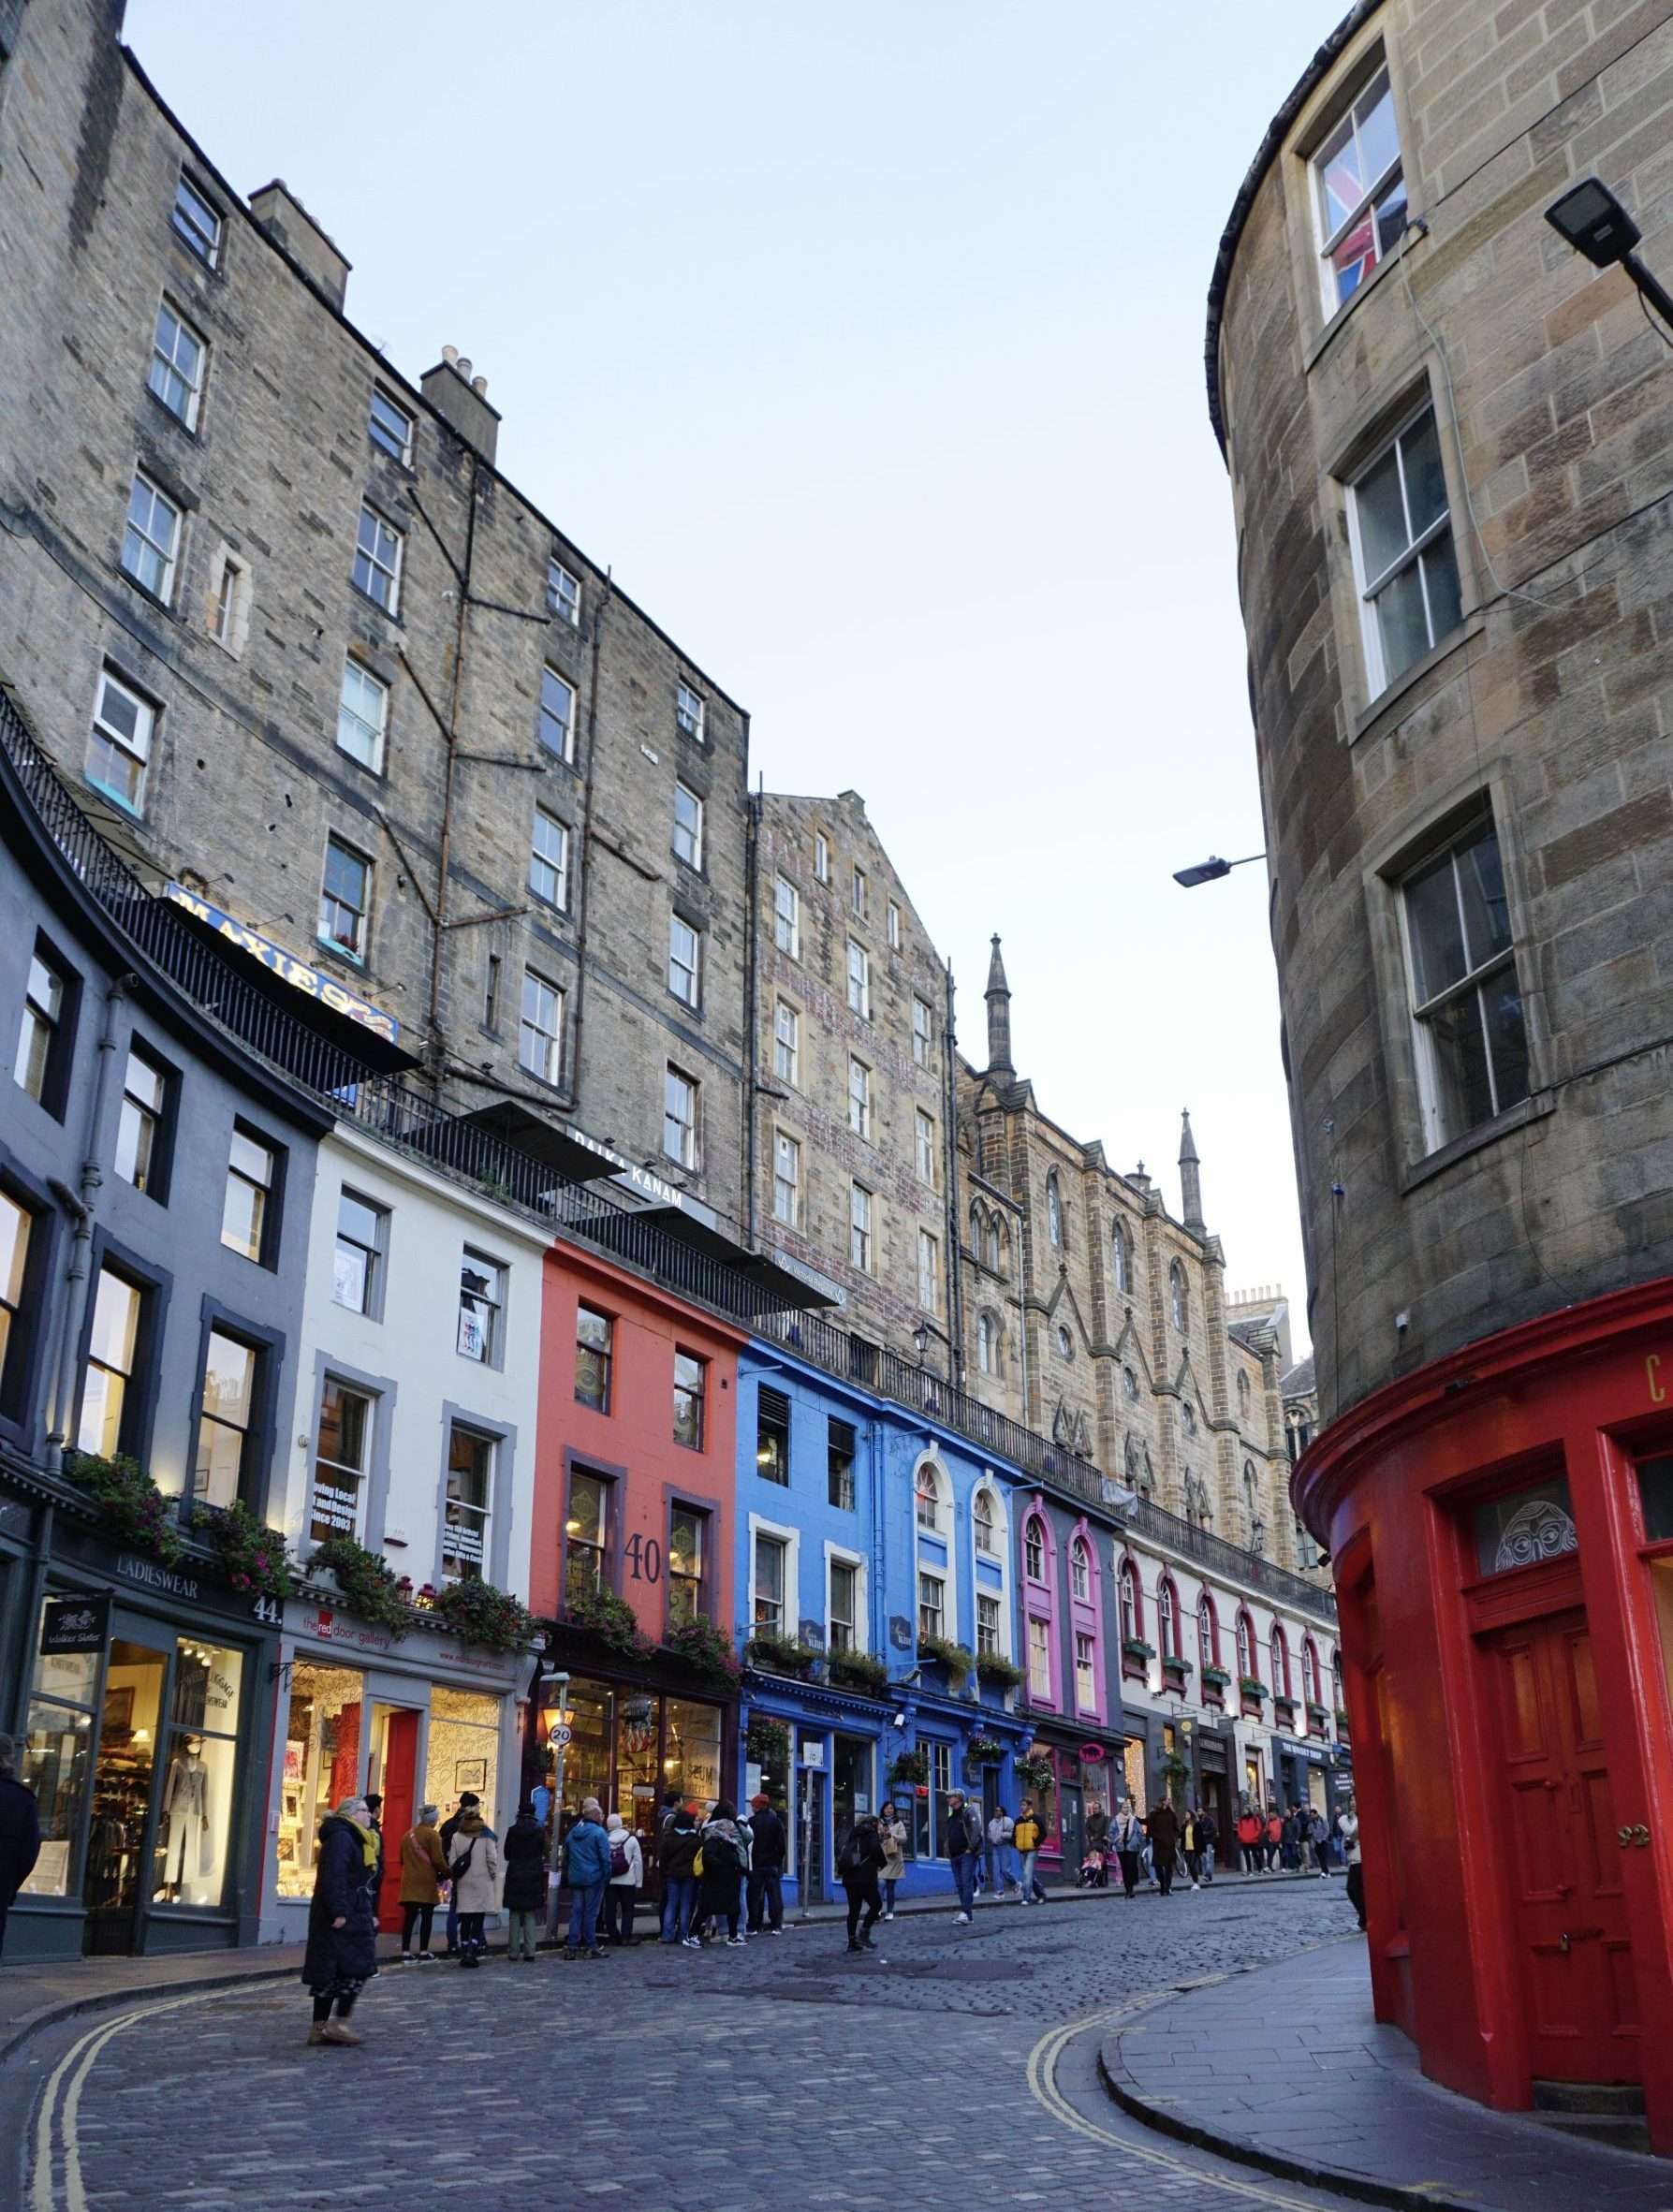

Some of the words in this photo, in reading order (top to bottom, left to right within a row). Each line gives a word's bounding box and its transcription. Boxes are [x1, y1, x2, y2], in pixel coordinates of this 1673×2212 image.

[624, 1532, 660, 1584] 40
[117, 1555, 198, 1599] LADIESWEAR
[318, 1622, 332, 1635] red
[333, 1626, 355, 1639] door
[359, 1632, 391, 1650] gallery
[553, 1729, 570, 1741] 20
